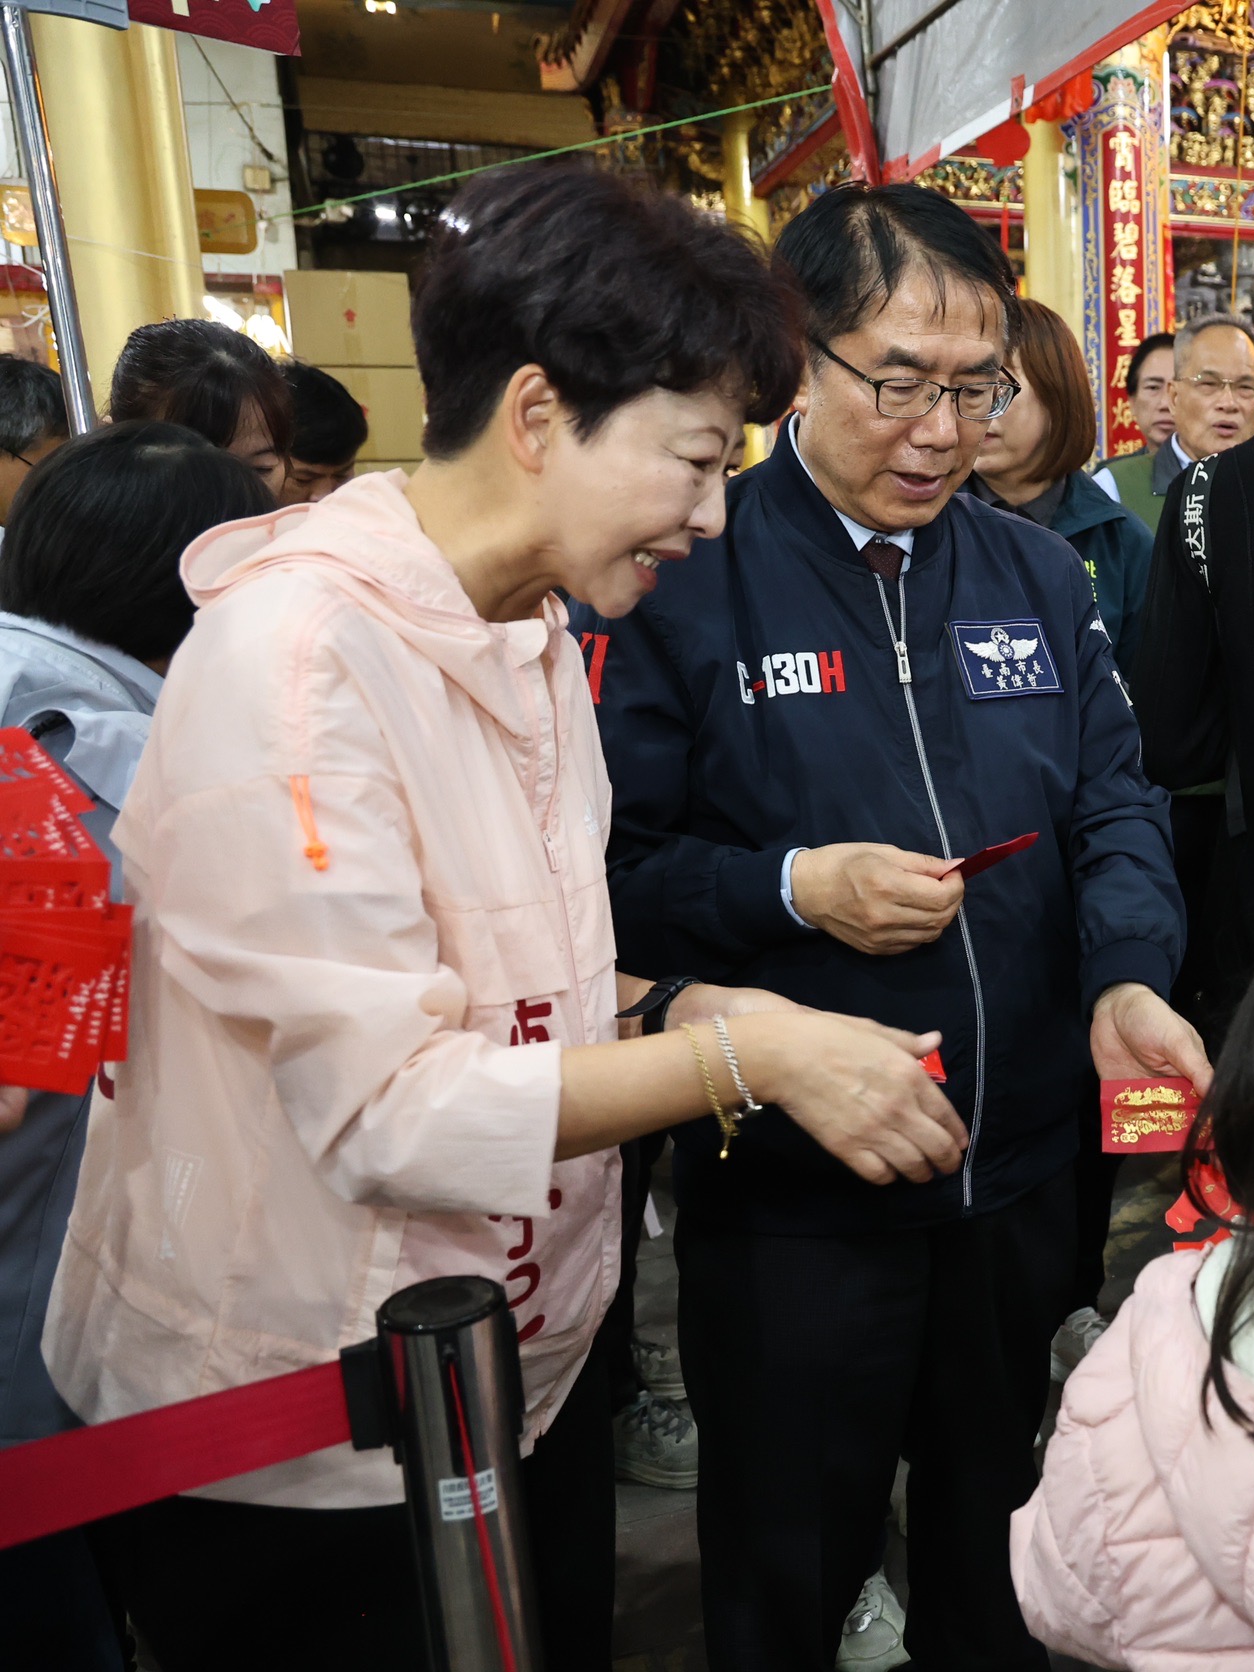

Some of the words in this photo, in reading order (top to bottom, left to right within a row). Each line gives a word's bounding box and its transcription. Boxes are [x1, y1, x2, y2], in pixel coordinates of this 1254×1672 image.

[736, 650, 846, 705] C-130H
[981, 660, 1044, 679] 臺南市長
